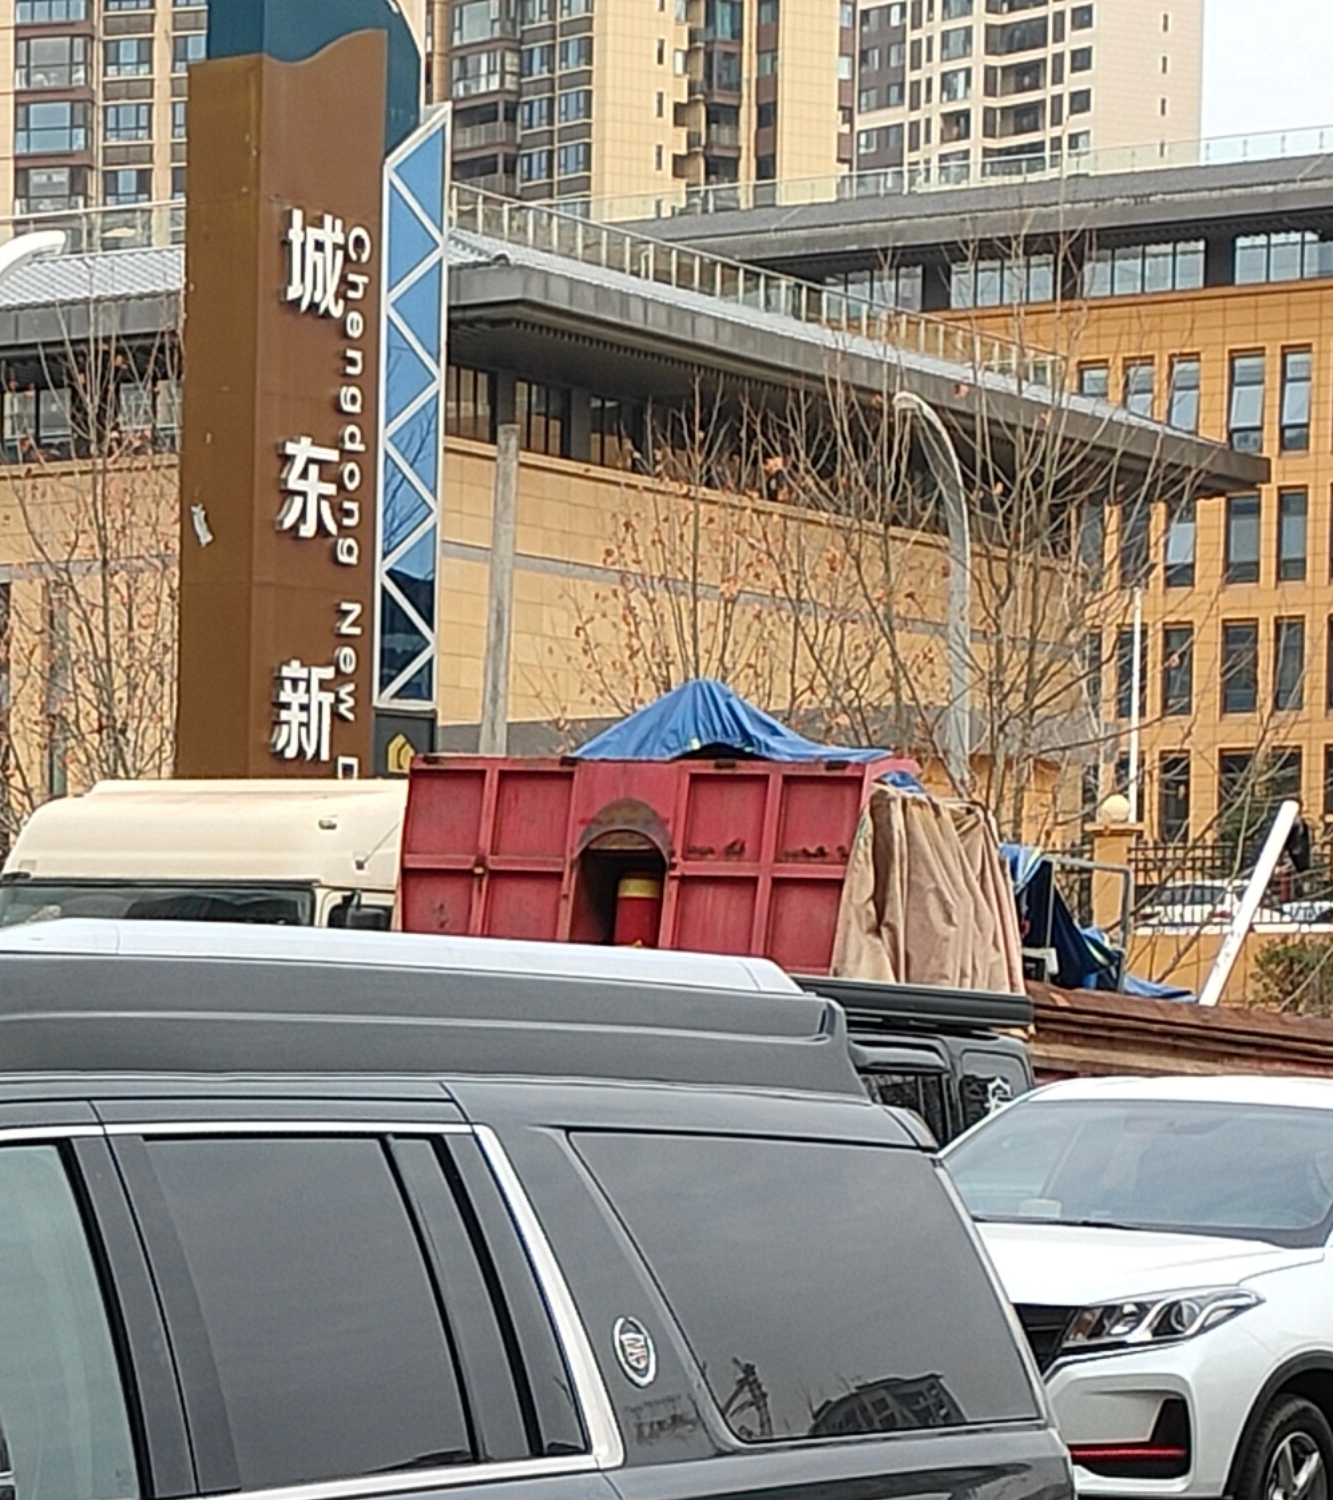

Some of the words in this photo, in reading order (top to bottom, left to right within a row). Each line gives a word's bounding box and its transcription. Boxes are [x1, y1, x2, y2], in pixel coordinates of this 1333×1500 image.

[277, 207, 345, 762] 城东新
[337, 226, 371, 565] Chengdong
[335, 602, 362, 721] New
